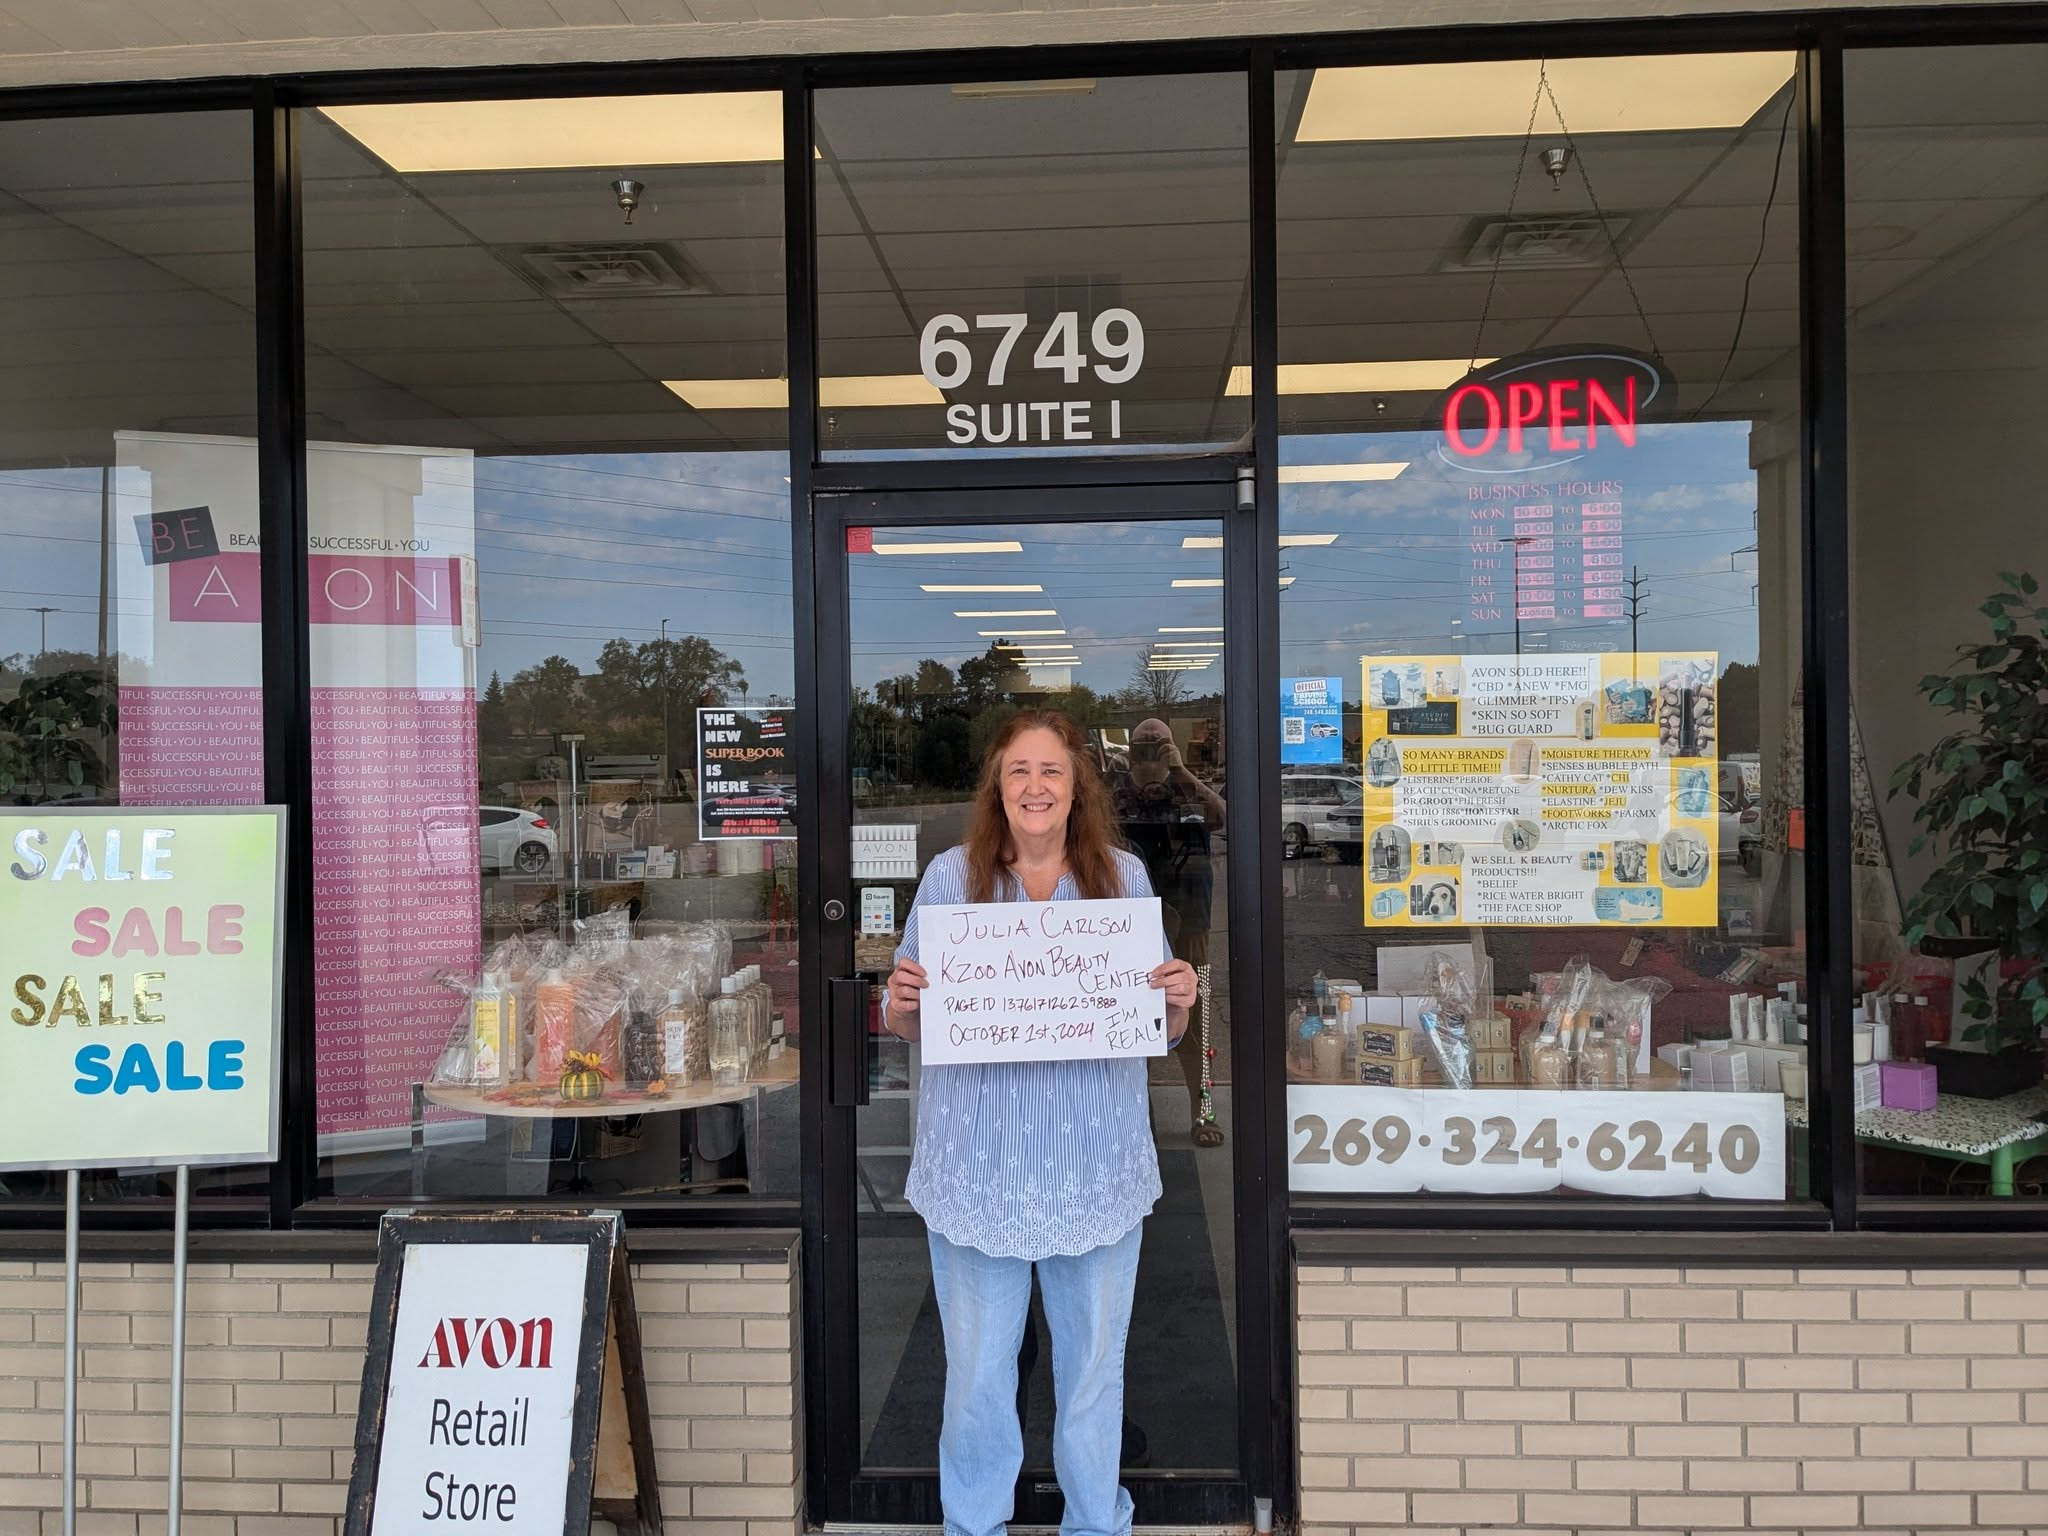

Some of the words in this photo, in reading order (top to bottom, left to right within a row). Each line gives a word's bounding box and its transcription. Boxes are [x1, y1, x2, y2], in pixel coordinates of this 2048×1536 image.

[920, 308, 1145, 389] 6749
[946, 401, 1093, 444] SUITE
[1111, 400, 1121, 439] I
[1444, 375, 1637, 457] OPEN
[1557, 480, 1623, 497] HOURS
[1470, 508, 1505, 520] MON
[1561, 504, 1574, 514] TO
[1471, 525, 1497, 537] TUE
[1561, 522, 1575, 531] TO
[150, 516, 205, 556] BE
[400, 539, 431, 552] YOU
[1471, 541, 1504, 553] WED
[1561, 540, 1575, 549] TO
[1471, 558, 1501, 569] THU
[1561, 556, 1575, 565] TO
[1471, 575, 1491, 587] FRI
[1562, 573, 1576, 582] TO
[193, 562, 438, 612] AON
[1471, 592, 1496, 604] SAT
[1562, 590, 1576, 599] TO
[1471, 608, 1501, 621] SUN
[1562, 607, 1576, 616] TO
[1471, 666, 1506, 677] AVON
[1509, 666, 1543, 677] SOLD
[1546, 666, 1587, 677] HERE!!
[1296, 680, 1325, 691] OFFICIAL
[151, 690, 215, 700] SUCCESSFUL
[219, 690, 243, 700] YOU
[370, 691, 392, 701] YOU
[400, 690, 446, 701] BEAUTIFUL
[177, 705, 201, 716] YOU
[208, 705, 261, 715] BEAUTIFUL
[331, 706, 353, 715] YOU
[360, 706, 409, 715] BEAUTIFUL
[414, 705, 472, 715] SUCCESSFUL
[1510, 710, 1527, 720] SO
[1530, 709, 1561, 720] SOFT
[370, 720, 393, 730] YOU
[400, 720, 448, 730] BEAUTIFUL
[704, 713, 736, 726] THE
[151, 721, 215, 731] SUCCESSFUL
[219, 721, 243, 731] YOU
[1508, 723, 1553, 734] GUARD
[177, 736, 201, 747] YOU
[208, 736, 262, 746] BEAUTIFUL
[361, 735, 410, 745] BEAUTIFUL
[415, 735, 472, 744] SUCCESSFUL
[705, 730, 742, 742] NEW
[151, 752, 216, 762] SUCCESSFUL
[219, 751, 243, 761] YOU
[1402, 750, 1418, 760] SO
[1420, 750, 1455, 760] MANY
[1457, 750, 1505, 760] BRANDS
[1602, 749, 1651, 759] THERAPY
[706, 764, 722, 776] IS
[1402, 763, 1418, 773] SO
[1421, 763, 1459, 773] LITTLE
[1461, 763, 1502, 773] TIME!!!
[1587, 761, 1629, 770] BUBBLE
[1631, 761, 1659, 770] BATH
[1583, 773, 1605, 783] CAT
[706, 781, 749, 793] HERE
[1630, 785, 1654, 794] KISS
[1403, 797, 1419, 805] DR
[1403, 808, 1439, 816] STUDIO
[1441, 818, 1497, 827] GROOMING
[1587, 821, 1608, 830] FOX
[862, 843, 908, 853] AVON
[10, 828, 176, 881] SALE
[362, 852, 412, 864] BEAUTIFUL
[1471, 855, 1488, 865] WE
[1490, 855, 1516, 865] SELL
[1520, 855, 1528, 864] K
[1531, 855, 1574, 864] BEAUTY
[1471, 868, 1538, 877] PRODUCTS!!!
[1509, 891, 1545, 900] WATER
[1547, 891, 1585, 900] BRIGHT
[1506, 903, 1533, 912] FACE
[1535, 903, 1562, 912] SHOP
[363, 910, 413, 923] BEAUTIFUL
[417, 910, 474, 922] SUCCESSFUL
[1506, 915, 1544, 924] CREAM
[1545, 915, 1574, 924] SHOP
[71, 904, 246, 958] SALE
[950, 911, 1032, 944] JULIA
[1041, 907, 1132, 939] CARLSON
[941, 951, 997, 985] KZOO
[1004, 950, 1046, 983] AVON
[1047, 945, 1109, 978] BEAUTY
[10, 971, 166, 1029] SALE
[944, 996, 979, 1015] PAGE
[983, 997, 996, 1011] ID
[336, 1006, 357, 1016] YOU
[364, 1003, 414, 1014] BEAUTIFUL
[949, 1023, 1020, 1047] OCTOBER
[73, 1039, 246, 1095] SALE
[429, 1397, 529, 1447] Retail
[422, 1471, 516, 1522] Store
